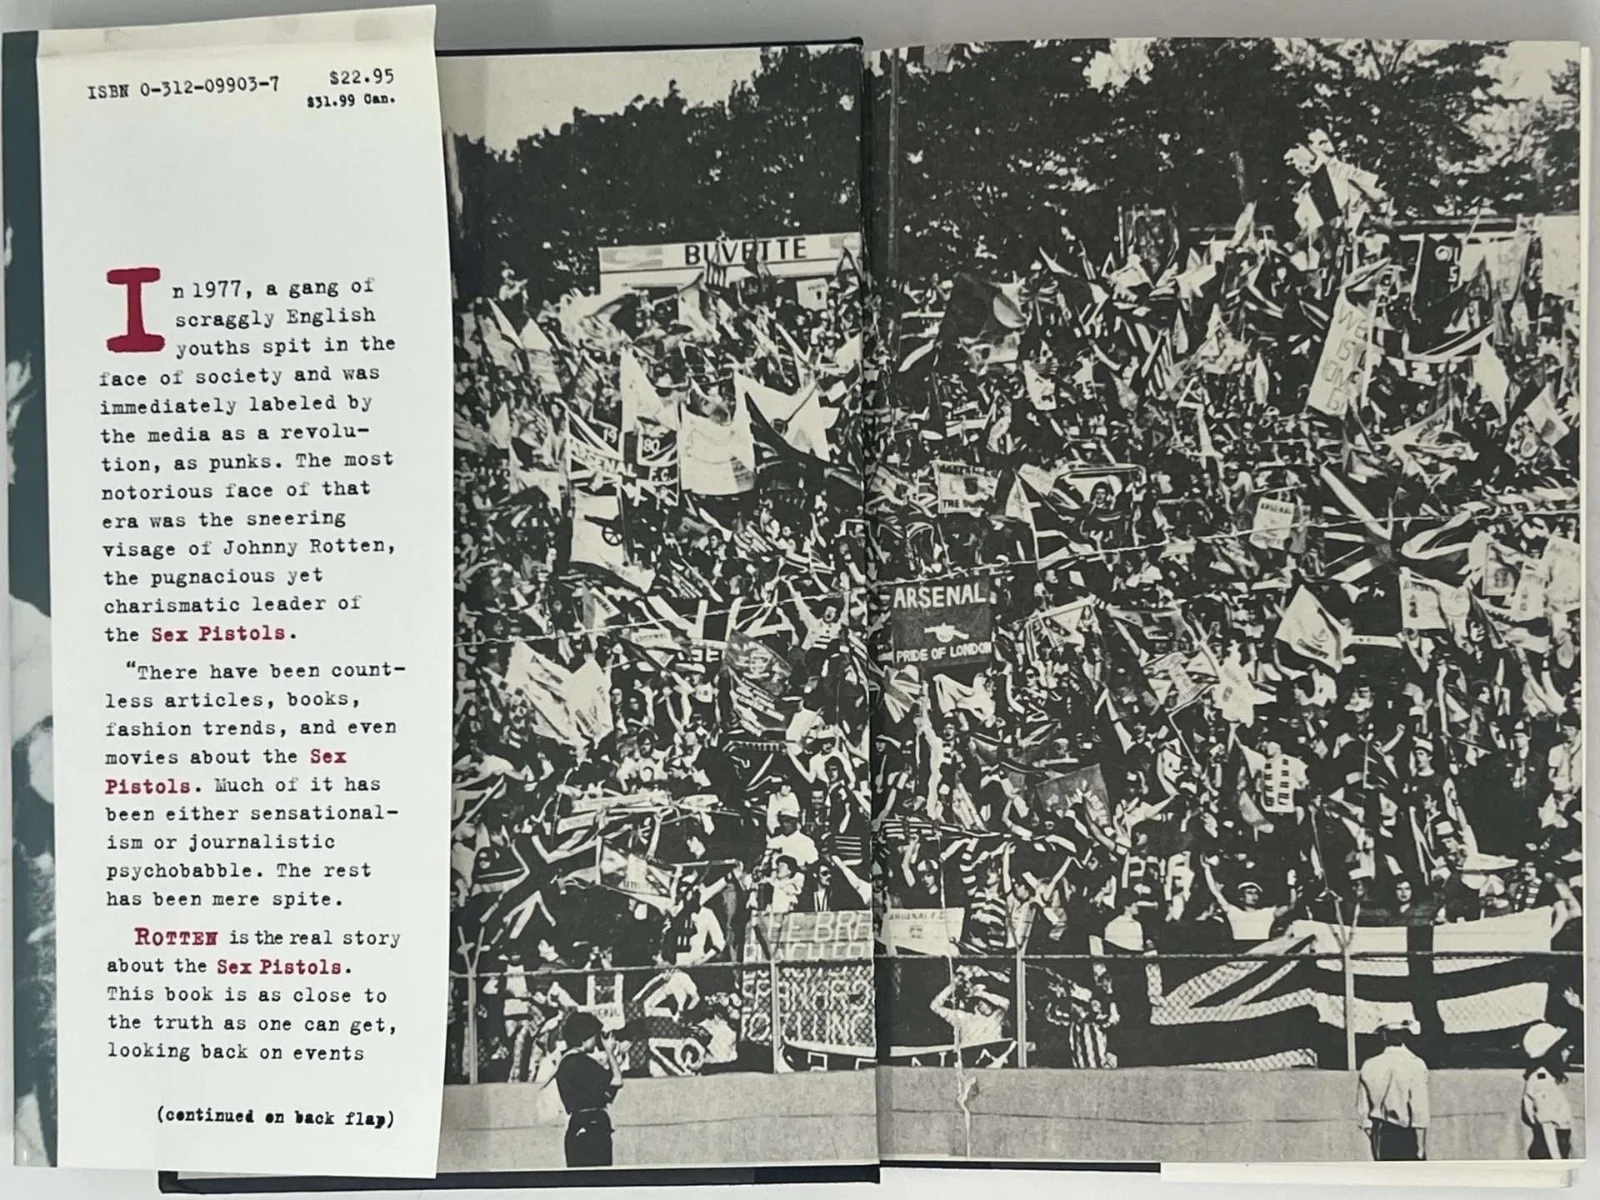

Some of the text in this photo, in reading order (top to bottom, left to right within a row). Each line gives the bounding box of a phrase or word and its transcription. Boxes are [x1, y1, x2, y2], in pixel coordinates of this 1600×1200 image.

[87, 74, 280, 100] ISBN 0-312-09903-7
[329, 67, 395, 86] $22.95
[306, 92, 396, 110] $31.99 Can.
[192, 279, 253, 300] 1977,
[265, 283, 279, 297] a
[288, 281, 340, 300] gang
[350, 277, 374, 294] of
[175, 306, 377, 331] scraggly English
[175, 335, 396, 361] youths spit in the
[98, 365, 380, 387] face of society and was
[99, 393, 373, 416] immediately labeled by
[99, 422, 370, 445] the media as a revolu-
[100, 450, 394, 475] tion, as punks. The most
[101, 479, 371, 501] notorious face of that
[101, 509, 347, 530] era was the sneering
[101, 537, 395, 561] visage of Johnny Rotten,
[102, 566, 323, 589] the pugnacious yet
[103, 595, 362, 615] charismatic leader of
[893, 582, 987, 609] ARSENAL
[103, 624, 297, 643] the Sex Pistols.
[896, 641, 993, 663] PRIDE OF LONDON
[209, 663, 259, 680] have
[269, 663, 320, 679] been
[331, 661, 407, 678] count-
[105, 690, 359, 710] less articles, books,
[105, 718, 397, 739] fashion trends, and even
[104, 748, 348, 766] movies about the Sex
[104, 776, 381, 795] Pistols. Much of it has
[104, 803, 399, 822] been either sensational-
[106, 833, 336, 853] ism or journalistic
[105, 861, 372, 882] psychobabble. The rest
[105, 890, 343, 910] has been mere spite.
[133, 926, 401, 949] ROTTEN is the real story
[106, 957, 352, 976] about the Sex Pistols.
[106, 985, 387, 1004] This book is as close to
[107, 1013, 396, 1037] the truth as one can get,
[107, 1041, 365, 1063] looking back on events
[157, 1104, 394, 1130] (continued on back flap)
